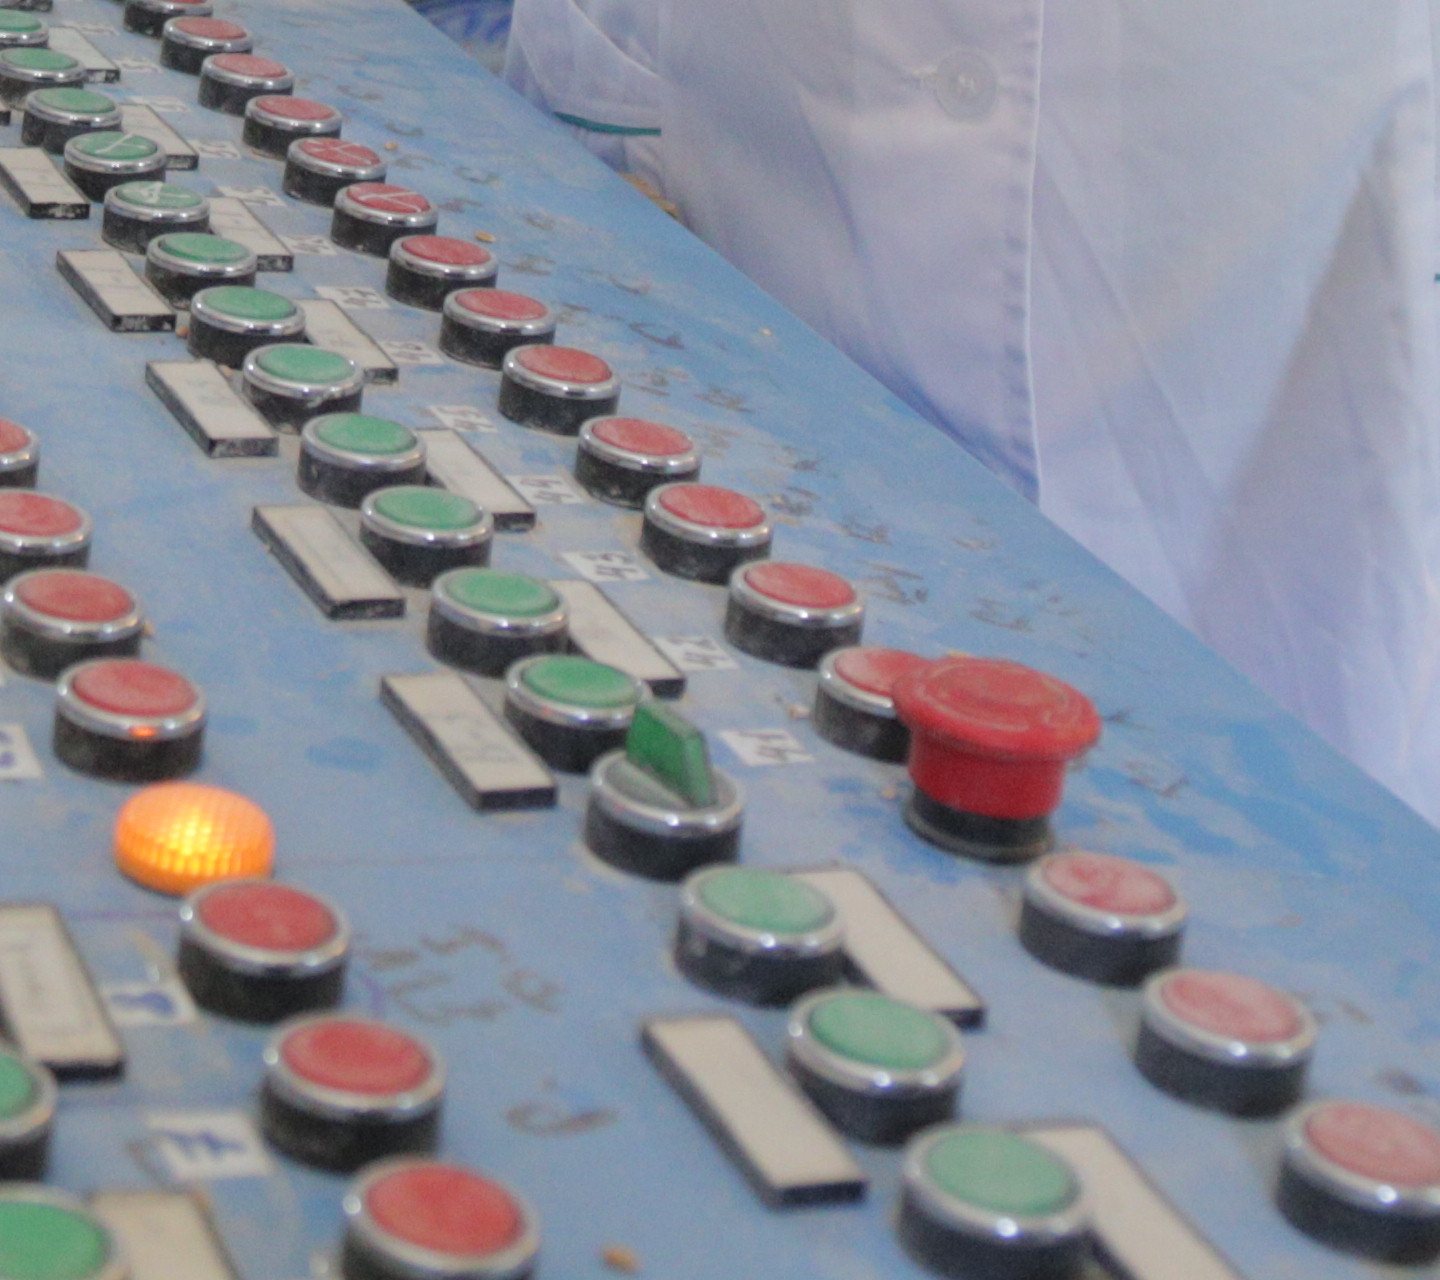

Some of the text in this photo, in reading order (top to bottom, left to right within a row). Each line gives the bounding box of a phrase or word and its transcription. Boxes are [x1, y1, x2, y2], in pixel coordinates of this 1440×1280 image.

[519, 477, 575, 505] 44
[580, 552, 638, 579] 43
[669, 637, 728, 667] 42
[739, 730, 807, 761] 41
